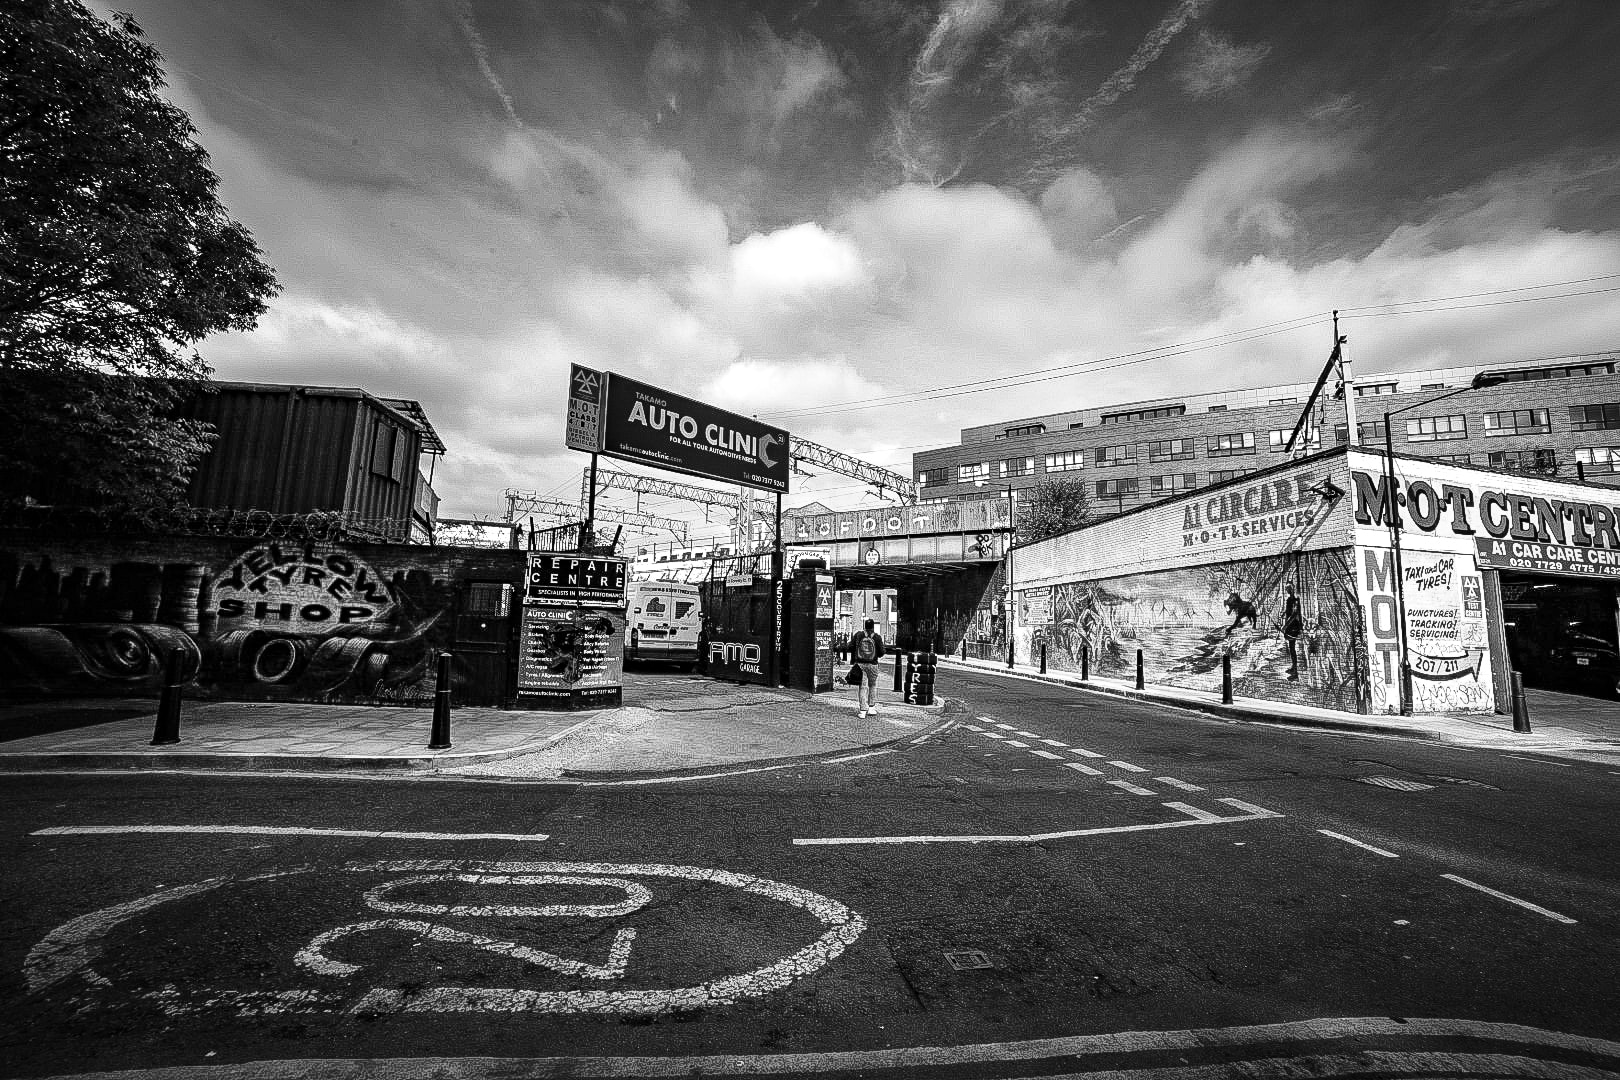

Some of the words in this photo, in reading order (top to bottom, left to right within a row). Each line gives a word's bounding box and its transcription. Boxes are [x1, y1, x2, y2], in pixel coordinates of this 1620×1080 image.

[636, 392, 667, 408] TAKAMO
[570, 411, 597, 423] CLASS
[628, 401, 698, 439] AUTO
[705, 423, 779, 469] CLINIC
[669, 436, 681, 445] FOR
[693, 442, 709, 452] YOUR
[709, 447, 741, 460] AUTOMOTIVE
[752, 475, 762, 483] 020
[1242, 510, 1314, 537] SERVICES
[1479, 490, 1620, 550] CENTR
[1492, 541, 1507, 556] A1
[1512, 543, 1543, 559] CAR
[1546, 546, 1584, 563] CARE
[532, 558, 624, 574] REPAIR
[1405, 566, 1425, 582] TAXI
[1438, 558, 1454, 572] CAR
[1510, 558, 1532, 569] 020
[1535, 560, 1563, 571] 7729
[1570, 563, 1595, 573] 4775
[531, 573, 624, 588] CENTRE
[1416, 572, 1453, 592] TYRES!
[538, 589, 569, 597] SPECIALISTS
[217, 599, 373, 624] SHOP
[1407, 608, 1458, 619] PUNCTURES!
[1466, 602, 1480, 610] TEST
[527, 610, 547, 618] AUTO
[1410, 620, 1458, 629] TRACKING!
[1410, 629, 1459, 640] SERVICING!
[740, 663, 764, 675] GARAGE
[907, 652, 923, 705] TYRES
